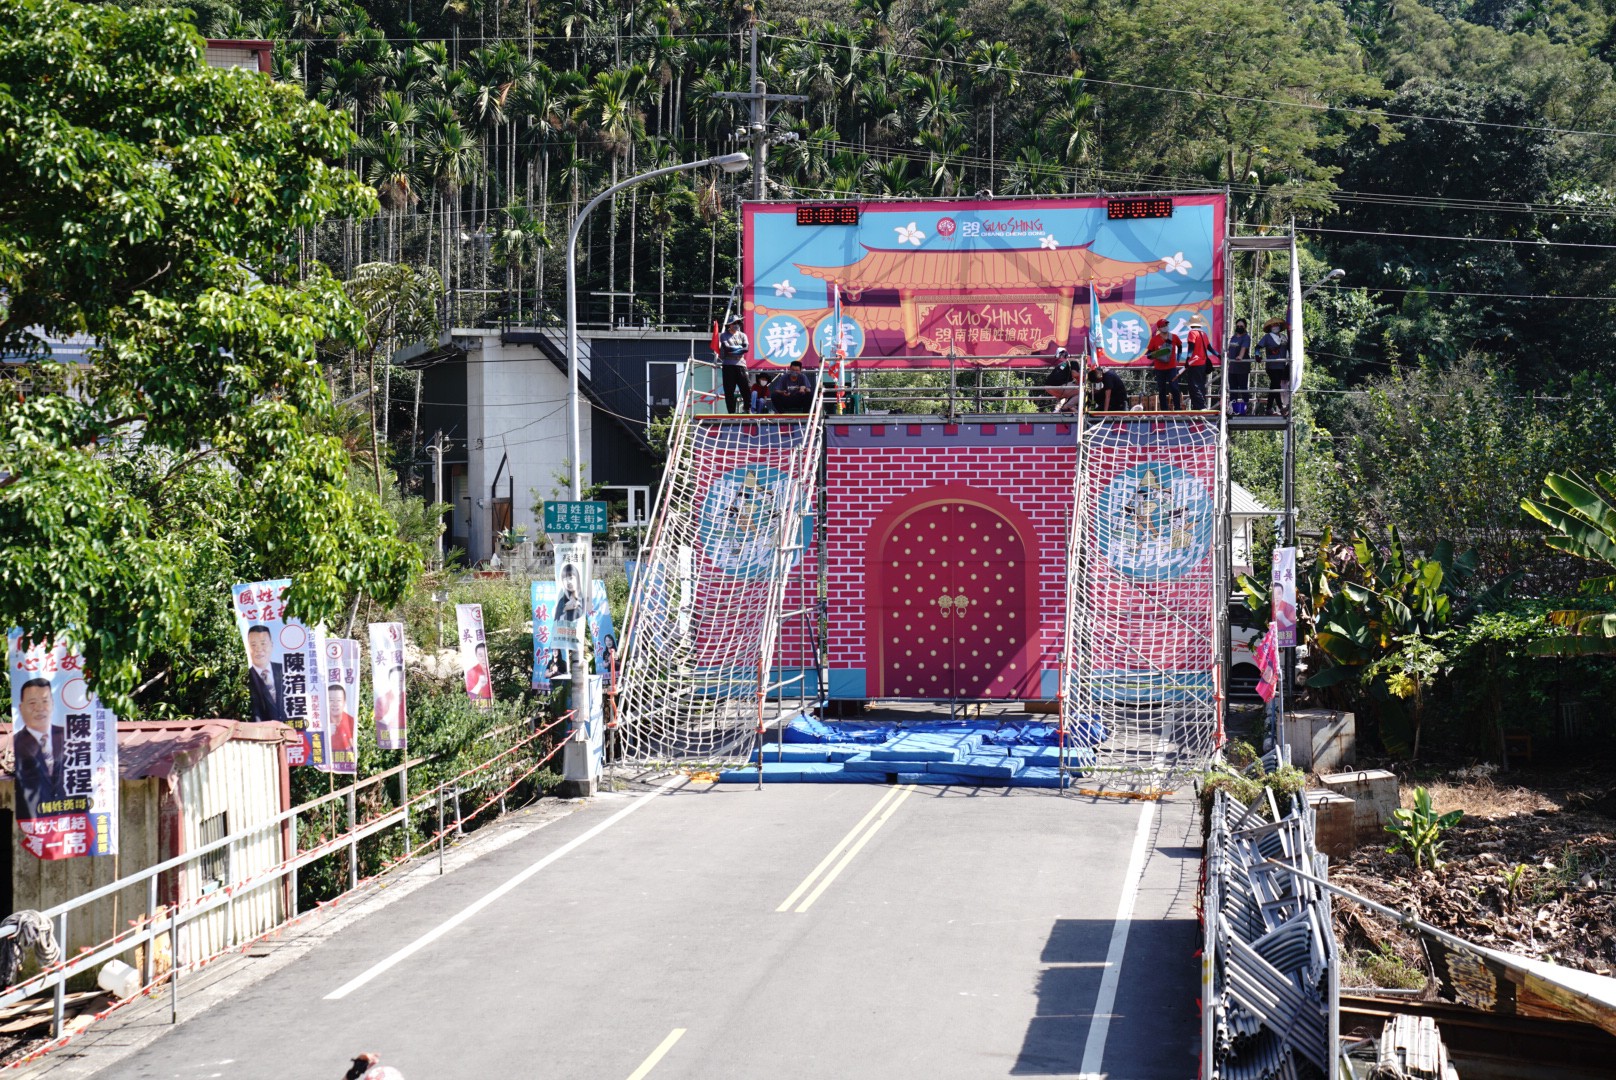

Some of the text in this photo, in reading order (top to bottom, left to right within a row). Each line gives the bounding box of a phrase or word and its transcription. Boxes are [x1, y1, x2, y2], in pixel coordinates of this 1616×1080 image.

[557, 503, 595, 515] 國姓路
[557, 514, 595, 524] 民生街
